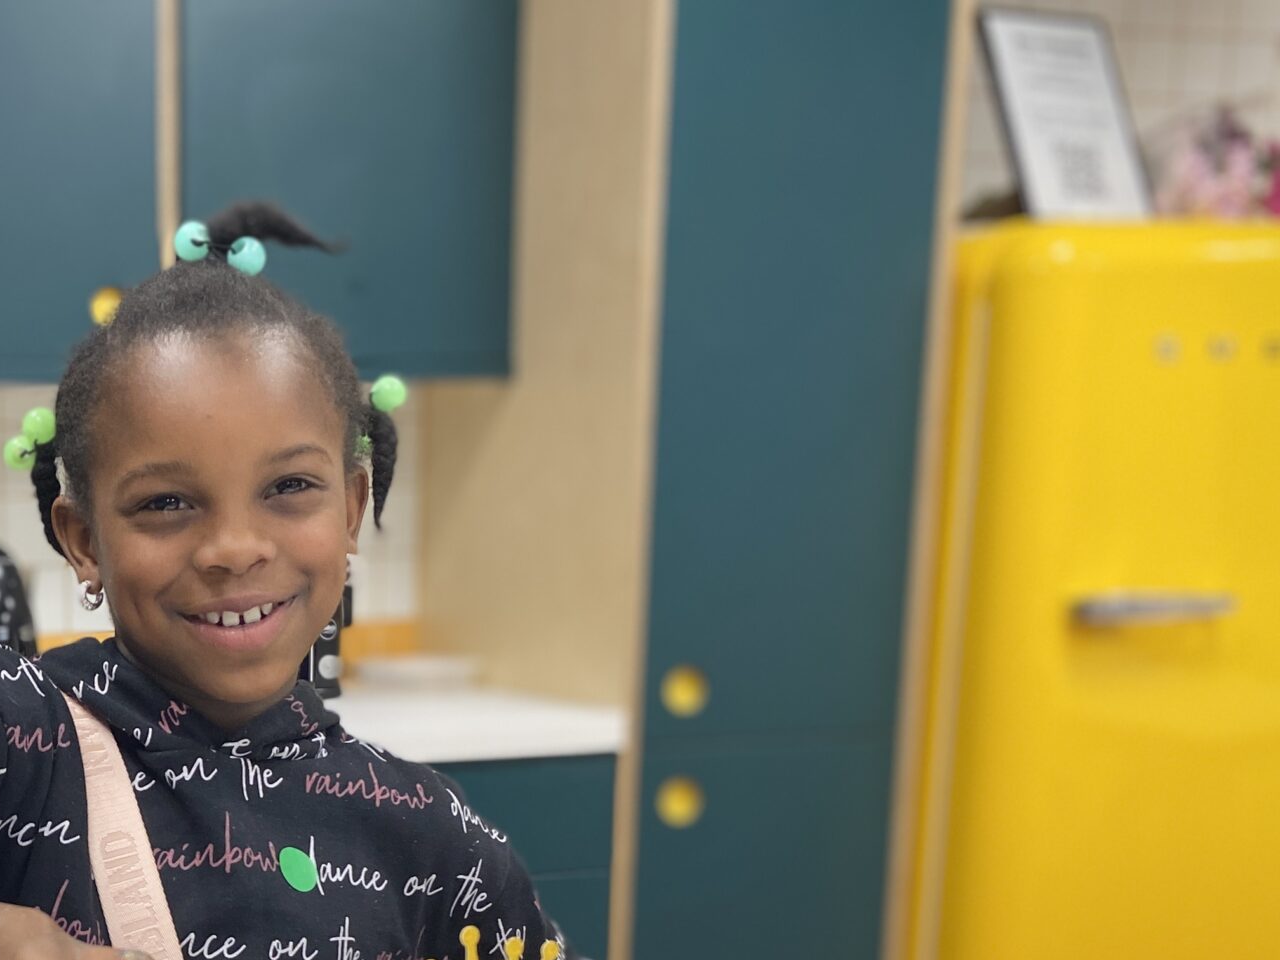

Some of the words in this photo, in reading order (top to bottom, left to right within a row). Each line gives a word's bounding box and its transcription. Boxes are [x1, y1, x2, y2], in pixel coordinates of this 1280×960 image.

[165, 757, 218, 790] on
[305, 762, 434, 808] rainbow
[404, 874, 443, 896] on
[450, 858, 492, 919] the
[180, 932, 246, 959] nce
[269, 937, 319, 960] on
